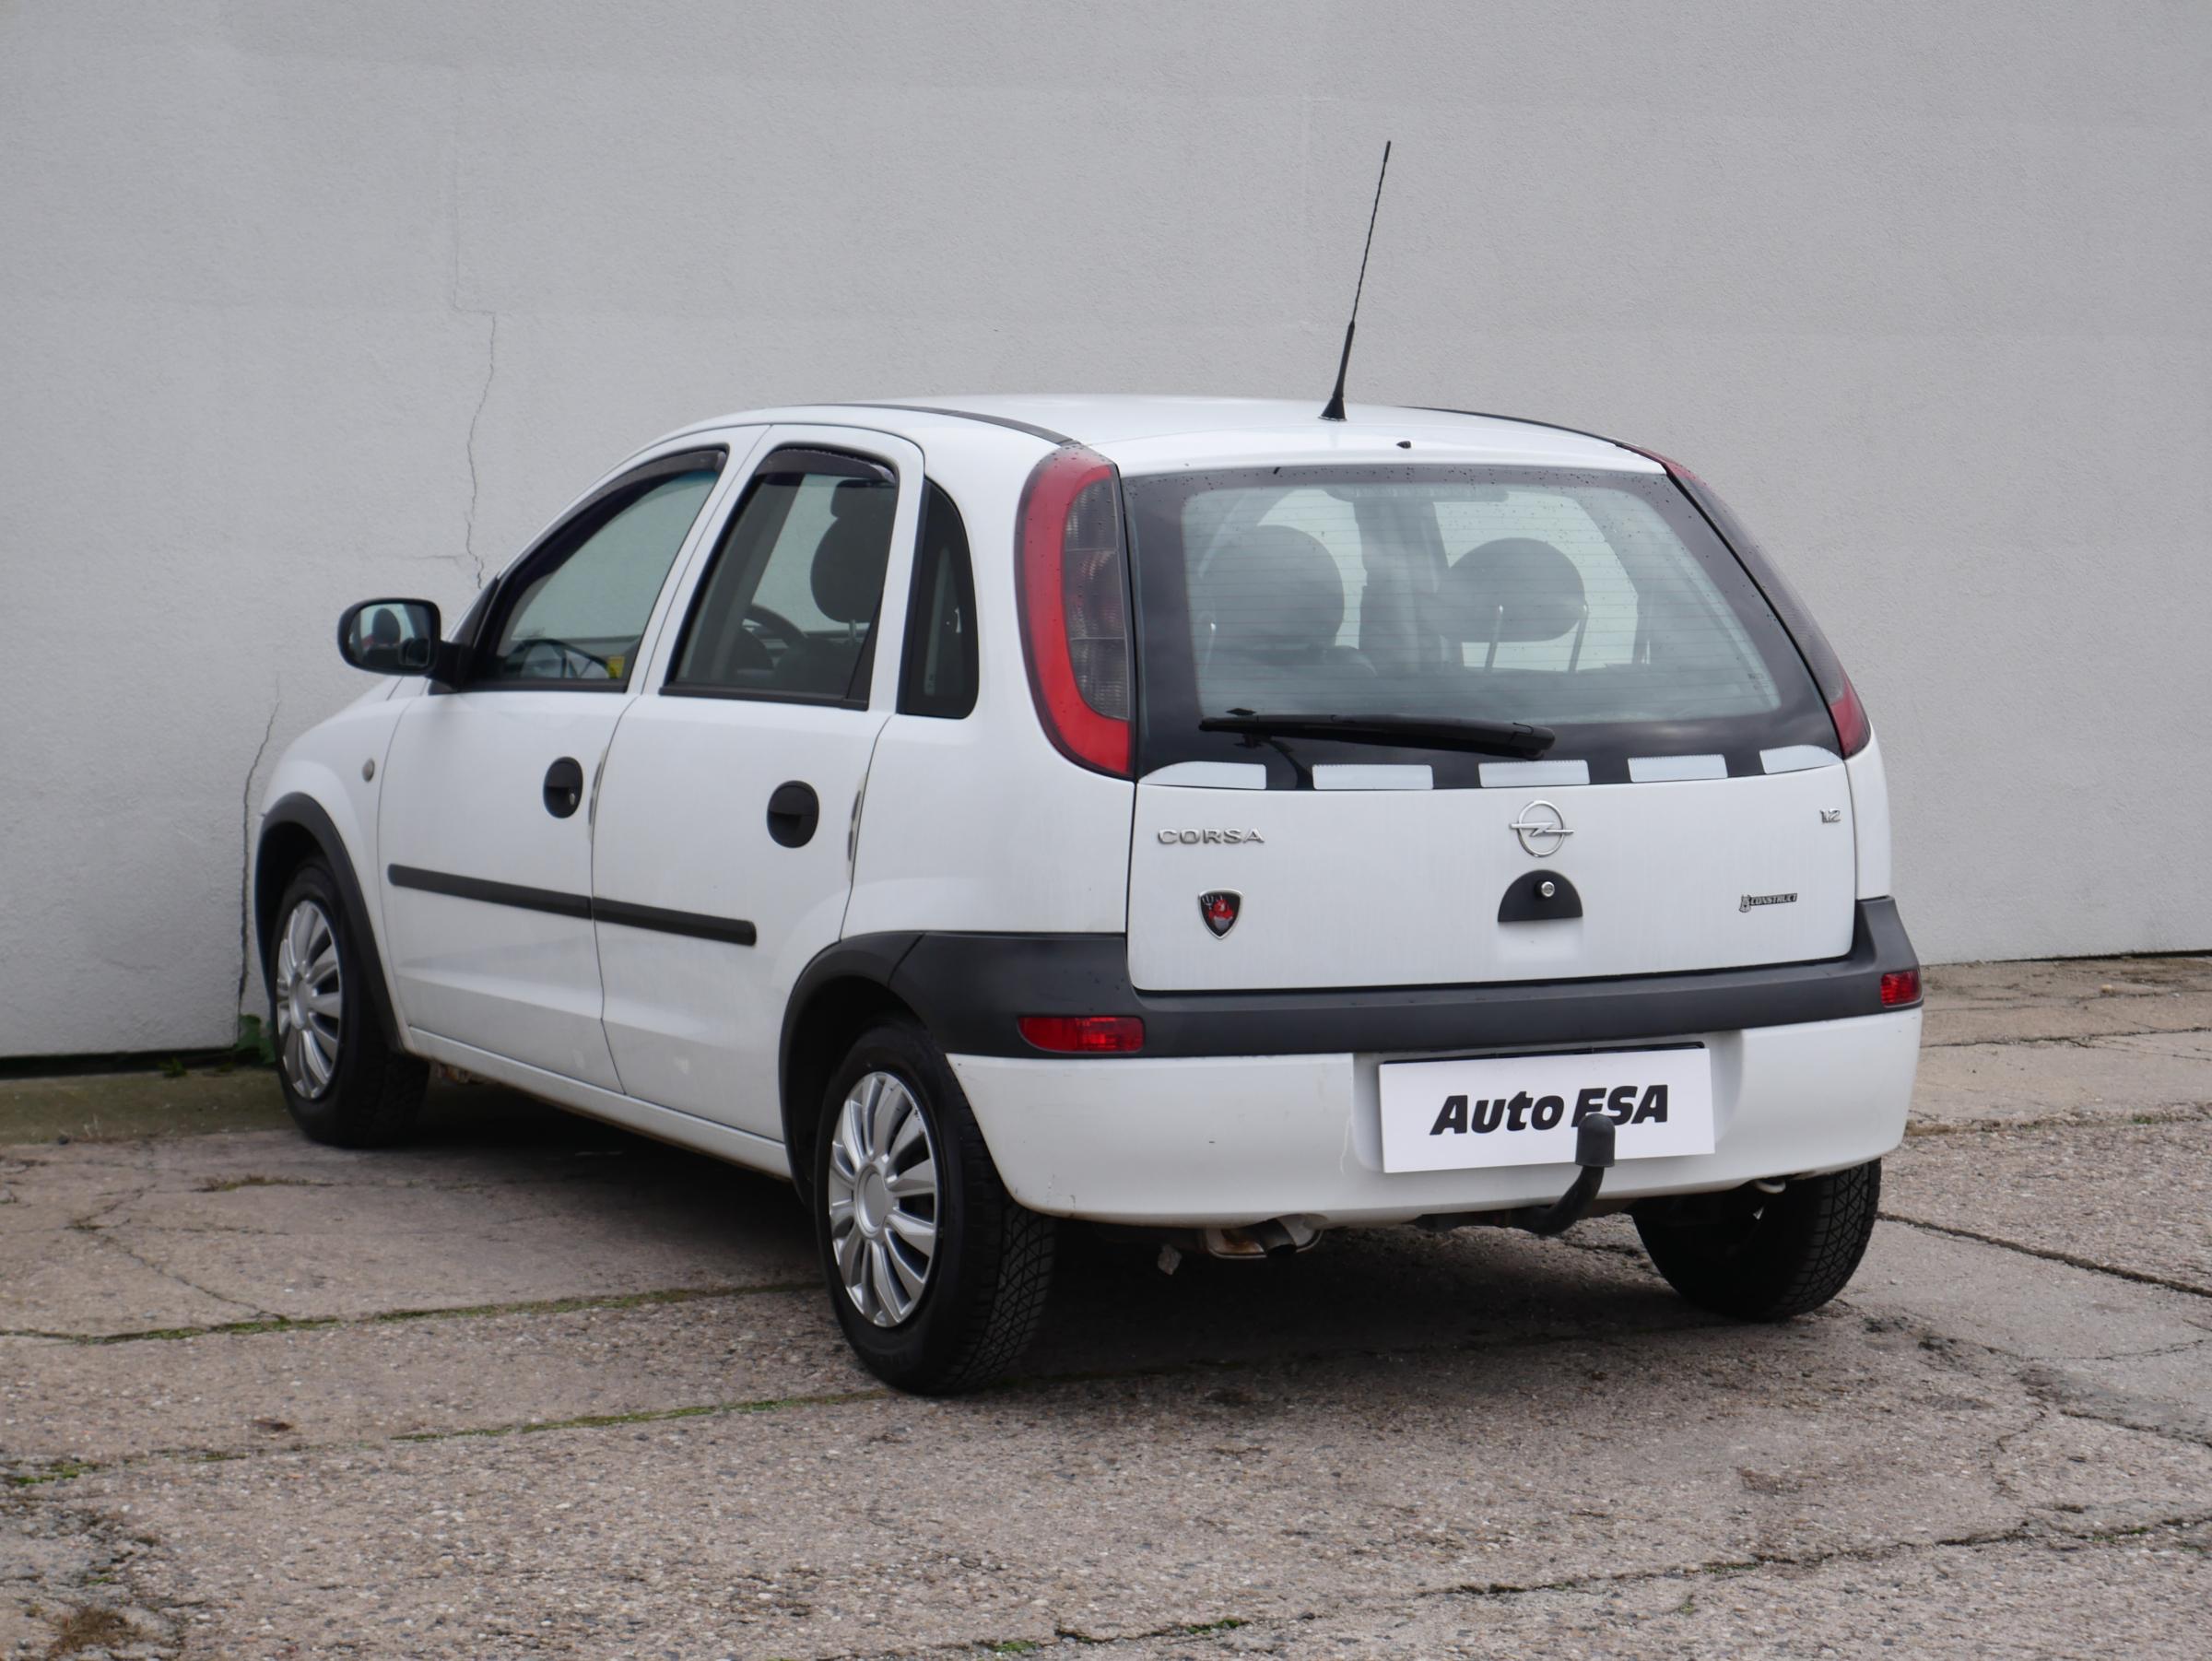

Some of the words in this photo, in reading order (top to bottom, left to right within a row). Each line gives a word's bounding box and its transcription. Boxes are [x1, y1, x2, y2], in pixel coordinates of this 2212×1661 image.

[1158, 828, 1265, 844] CORSA
[1750, 893, 1796, 905] CONSTRUCT
[1430, 1091, 1565, 1136] Auto
[1571, 1084, 1668, 1127] ESA
